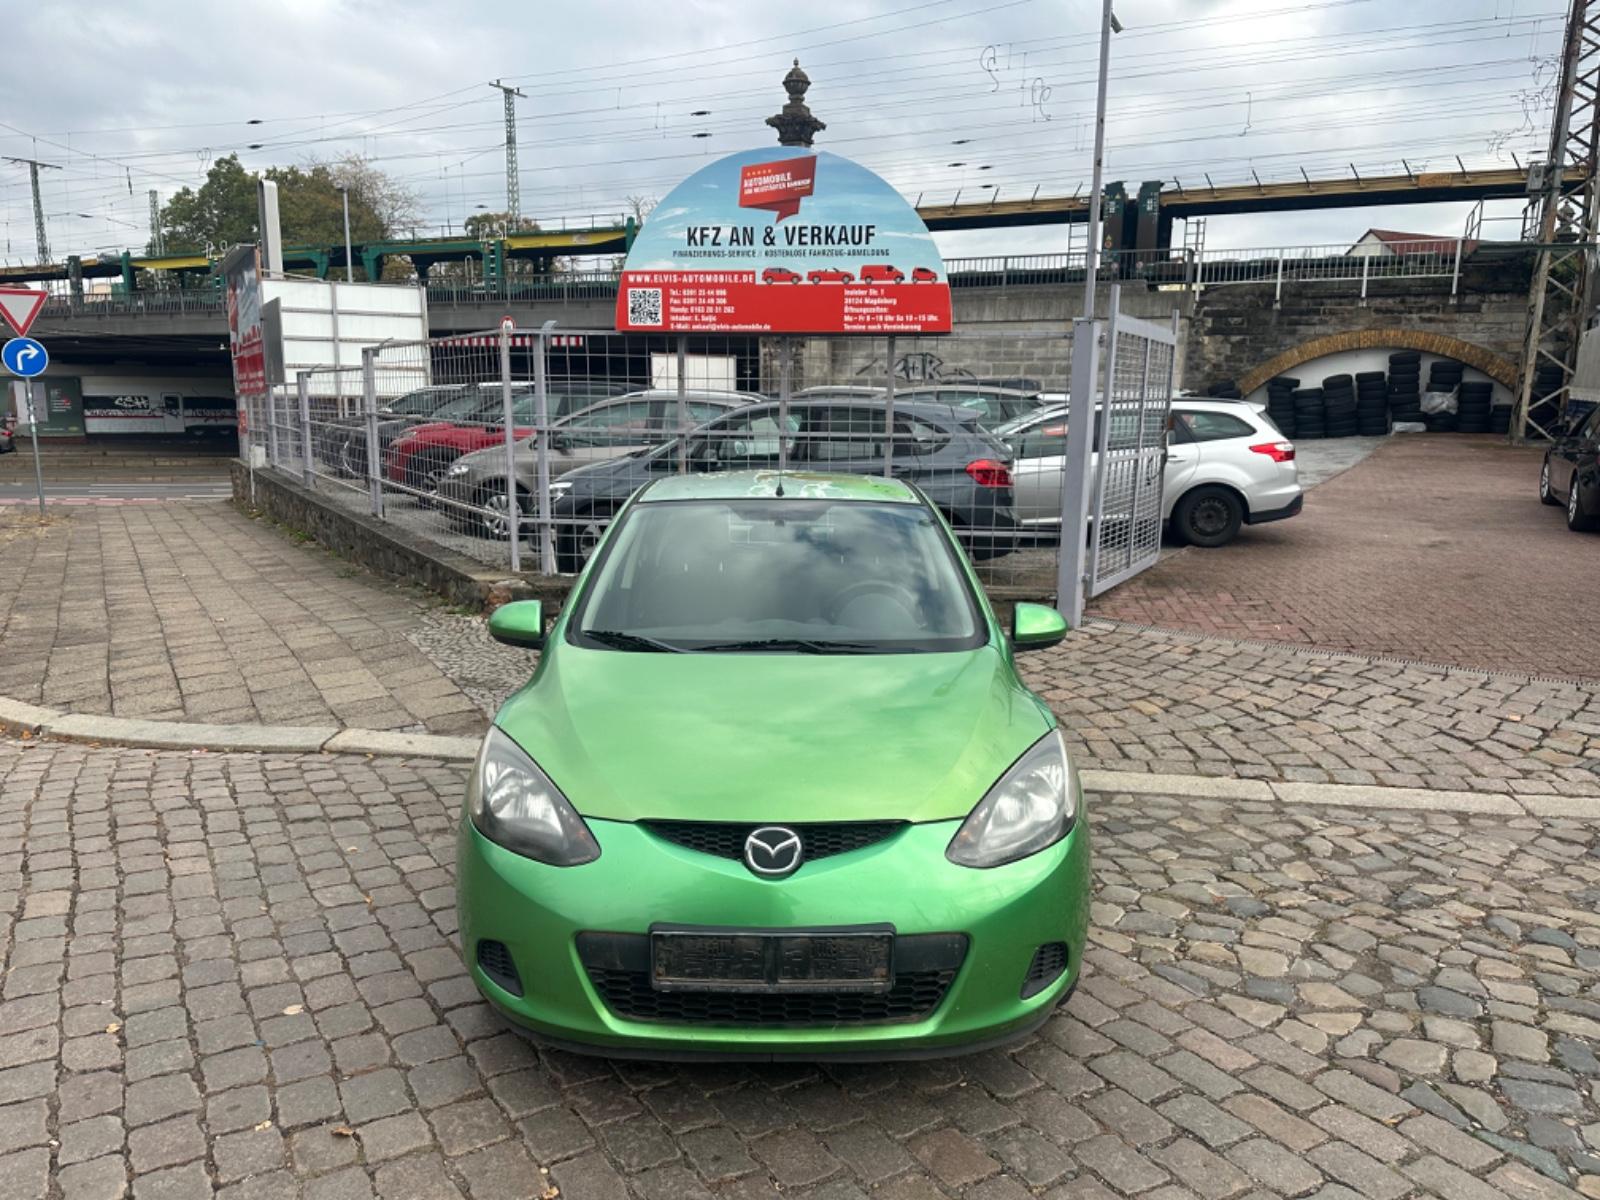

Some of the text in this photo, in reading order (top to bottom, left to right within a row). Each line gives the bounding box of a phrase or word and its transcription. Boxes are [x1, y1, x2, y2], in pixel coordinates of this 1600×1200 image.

[744, 172, 792, 188] AUTOMOBILE
[687, 225, 876, 247] KFZ AN & VERKAUF
[672, 249, 757, 258] FINANZIERUNGS-SERVICE
[764, 249, 806, 258] KOSTENLOSE
[809, 249, 890, 257] FAHRZEUG-ABMELDUNG
[628, 274, 754, 283] WWW.ELVIS-AUTOMOBILE.DE
[864, 297, 897, 306] Magdeburg
